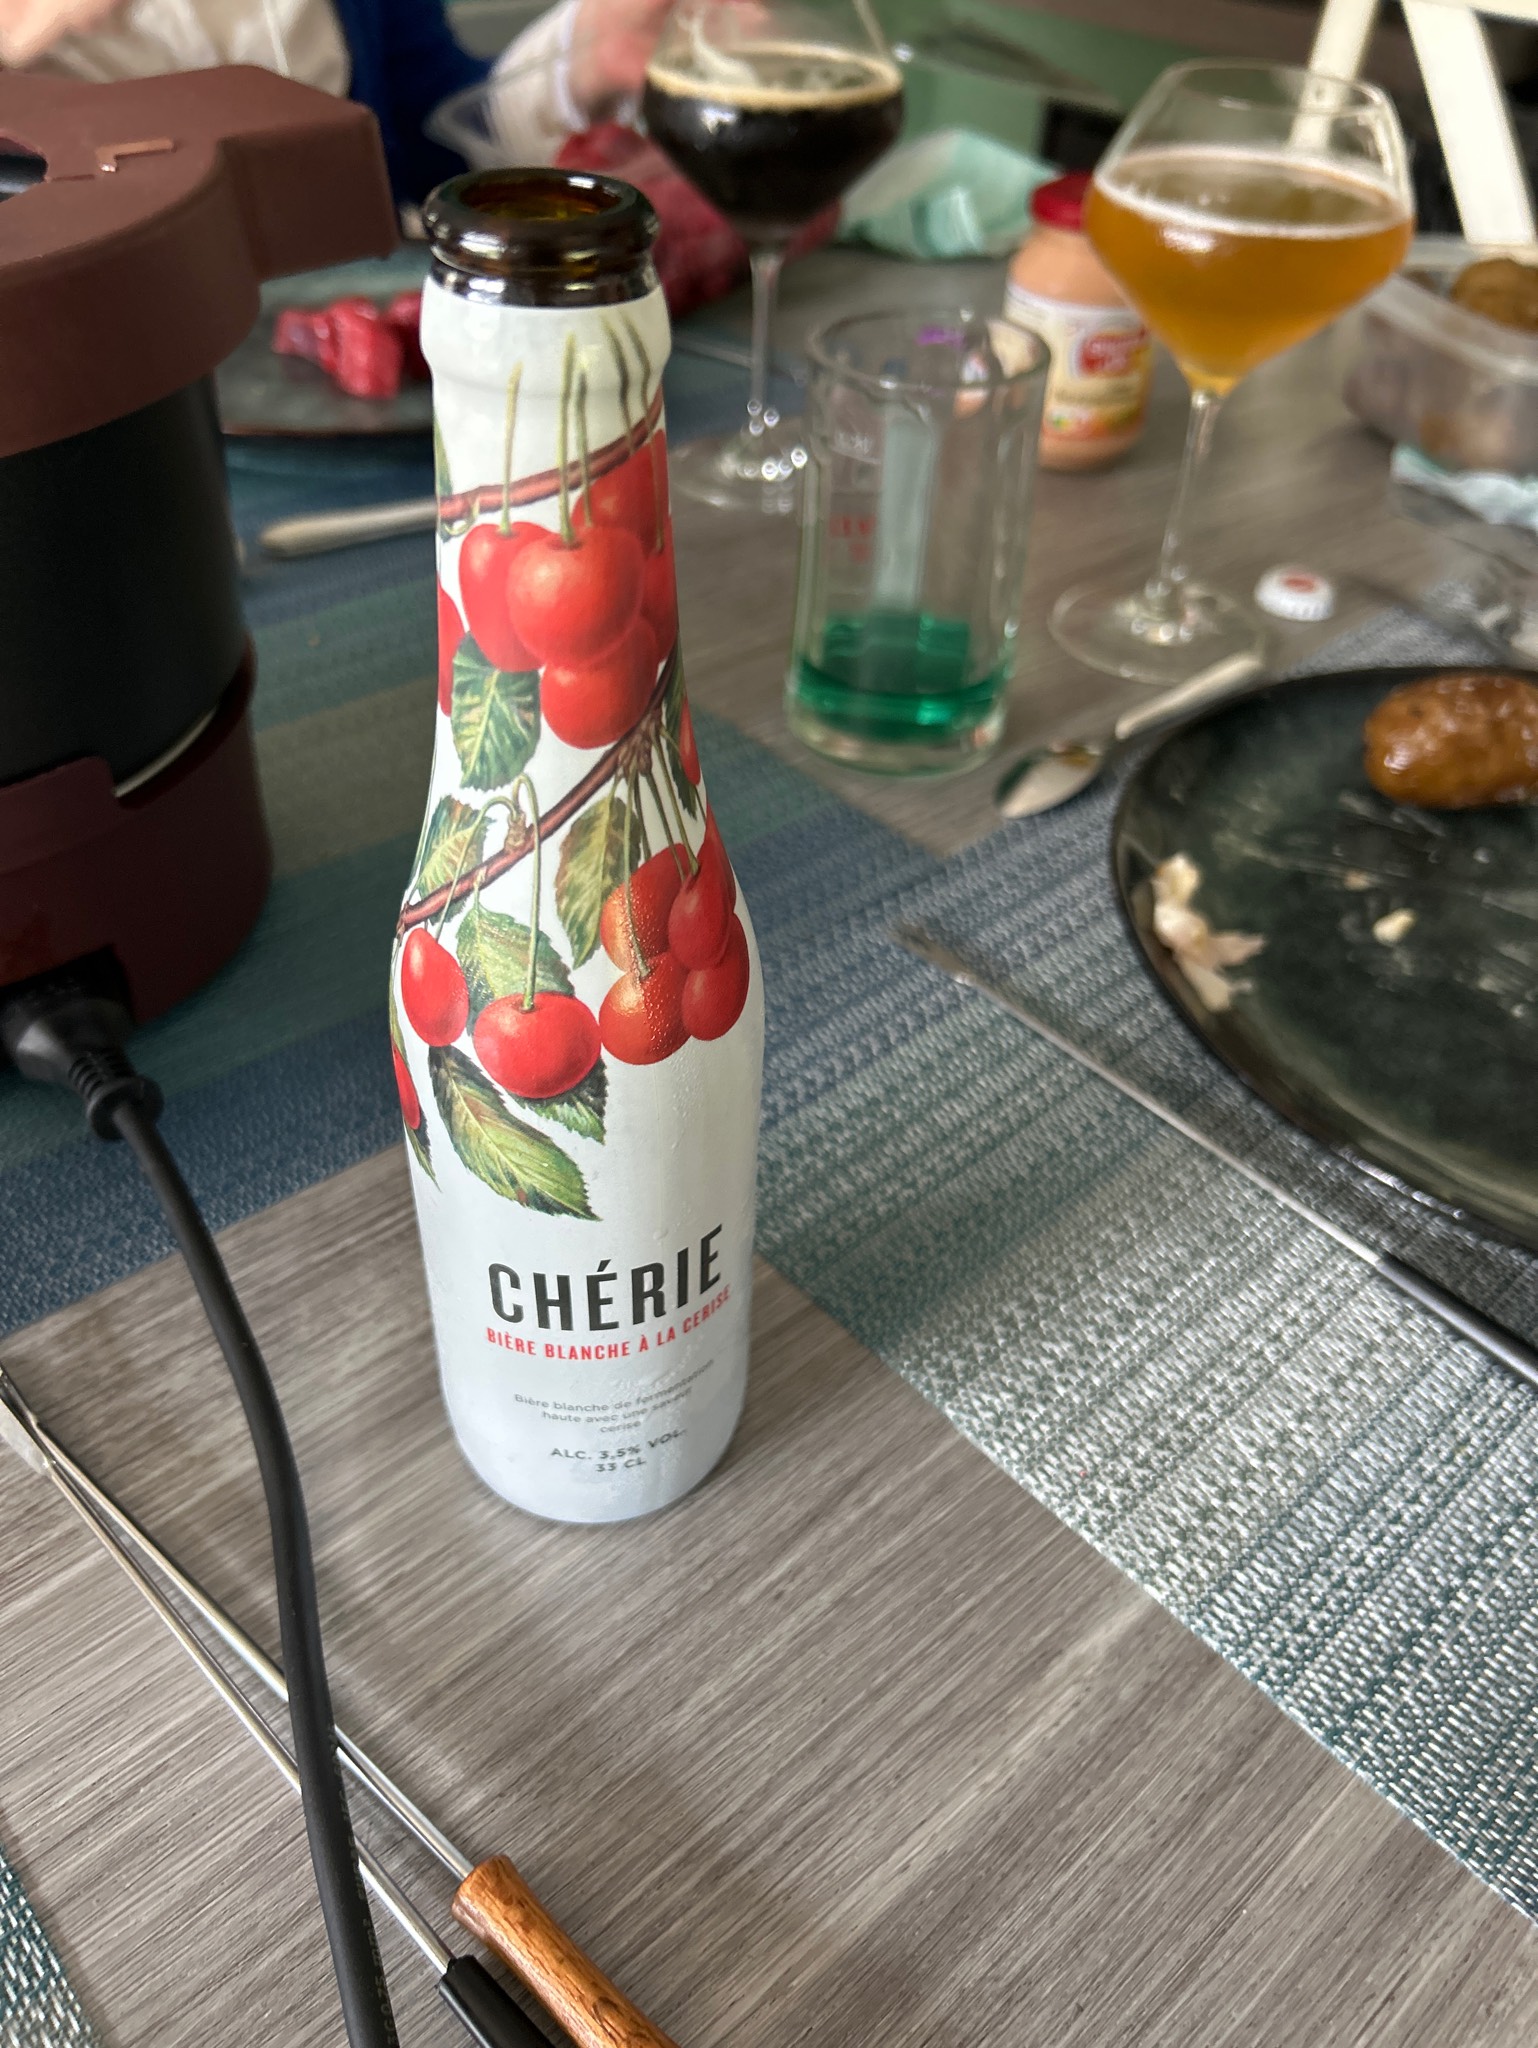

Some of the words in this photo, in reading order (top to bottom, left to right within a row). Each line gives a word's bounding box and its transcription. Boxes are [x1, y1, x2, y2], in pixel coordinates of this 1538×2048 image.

[488, 1223, 722, 1332] CHÉRIE
[486, 1327, 536, 1356] BIÈRE
[545, 1341, 631, 1360] BLANCHE
[638, 1330, 650, 1353] À
[657, 1326, 676, 1347] LA
[683, 1284, 731, 1334] CERISE
[514, 1393, 550, 1408] Bière
[553, 1400, 609, 1412] blanche
[614, 1399, 632, 1409] de
[542, 1411, 582, 1423] haute
[586, 1413, 619, 1423] avec
[623, 1408, 648, 1420] une
[600, 1420, 641, 1433] cerise
[551, 1448, 592, 1460] ALC.
[596, 1462, 617, 1472] 33
[624, 1457, 647, 1469] CL
